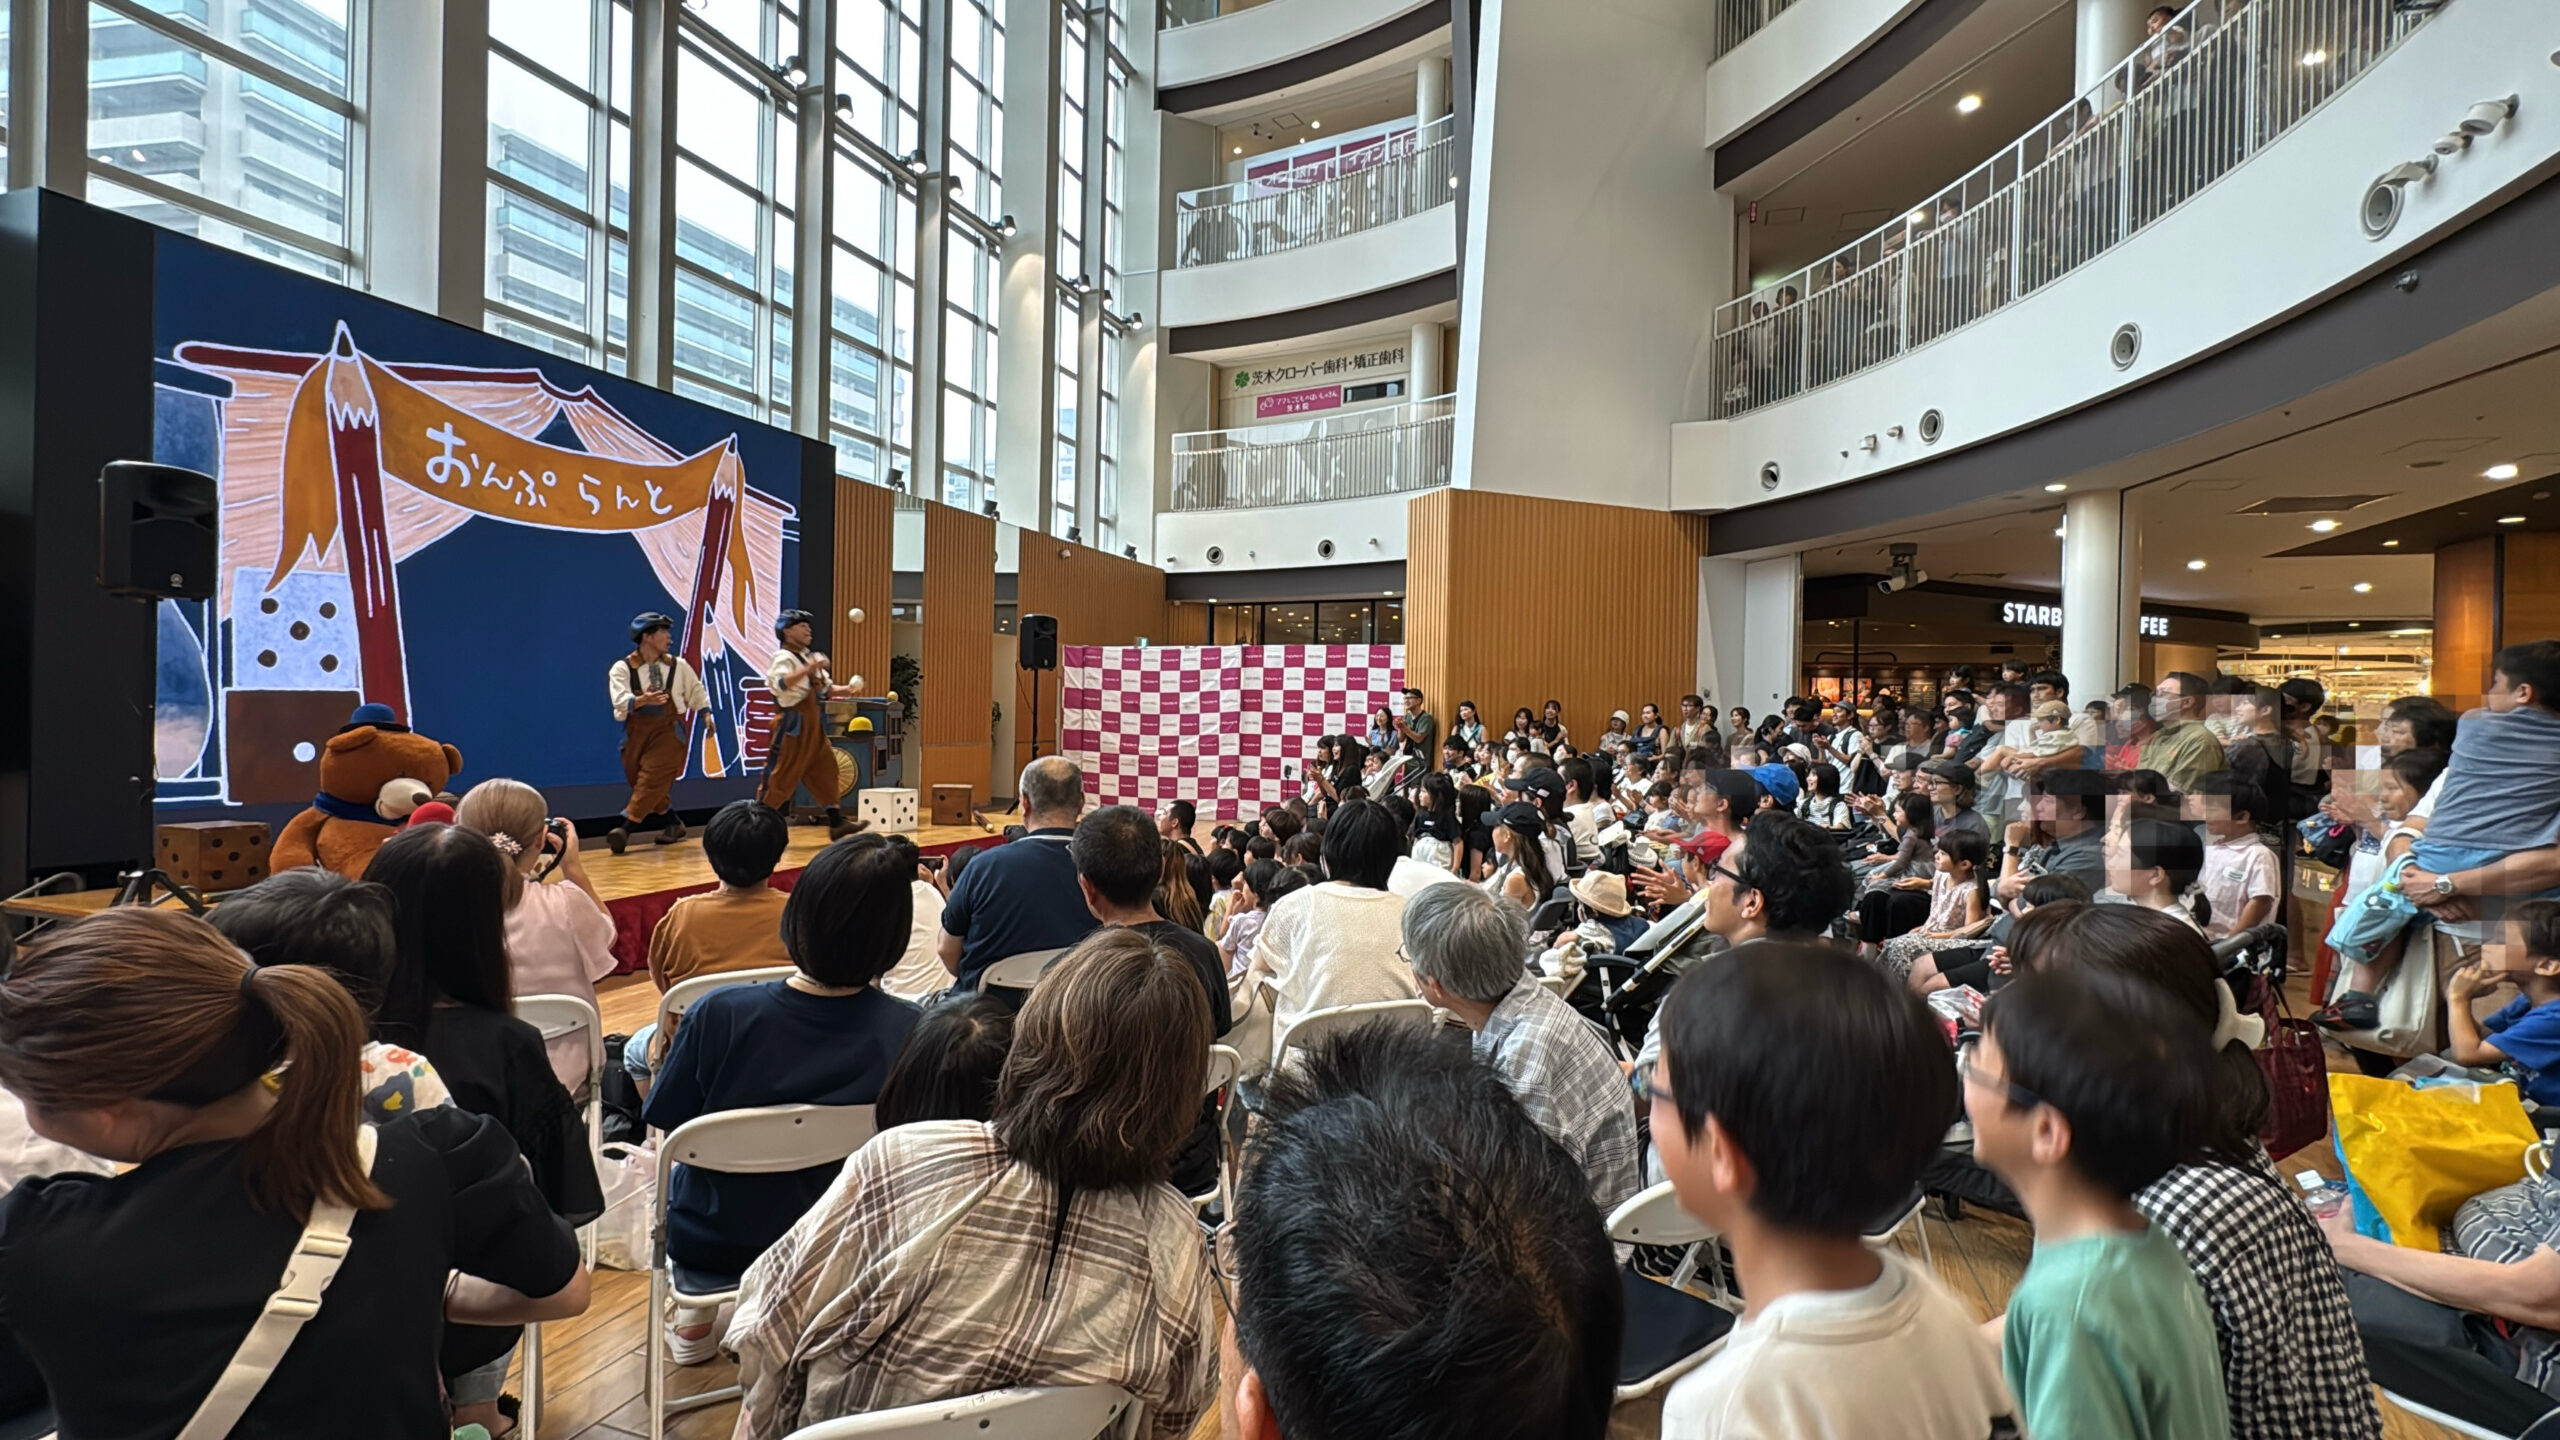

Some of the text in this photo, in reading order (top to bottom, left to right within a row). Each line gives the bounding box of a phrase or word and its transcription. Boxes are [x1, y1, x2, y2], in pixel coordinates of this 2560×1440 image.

[1252, 348, 1404, 385] 茨木クローバー歯科・矯正歯科
[426, 422, 673, 515] おんぷ らんと
[2003, 603, 2168, 636] STARB FEE
